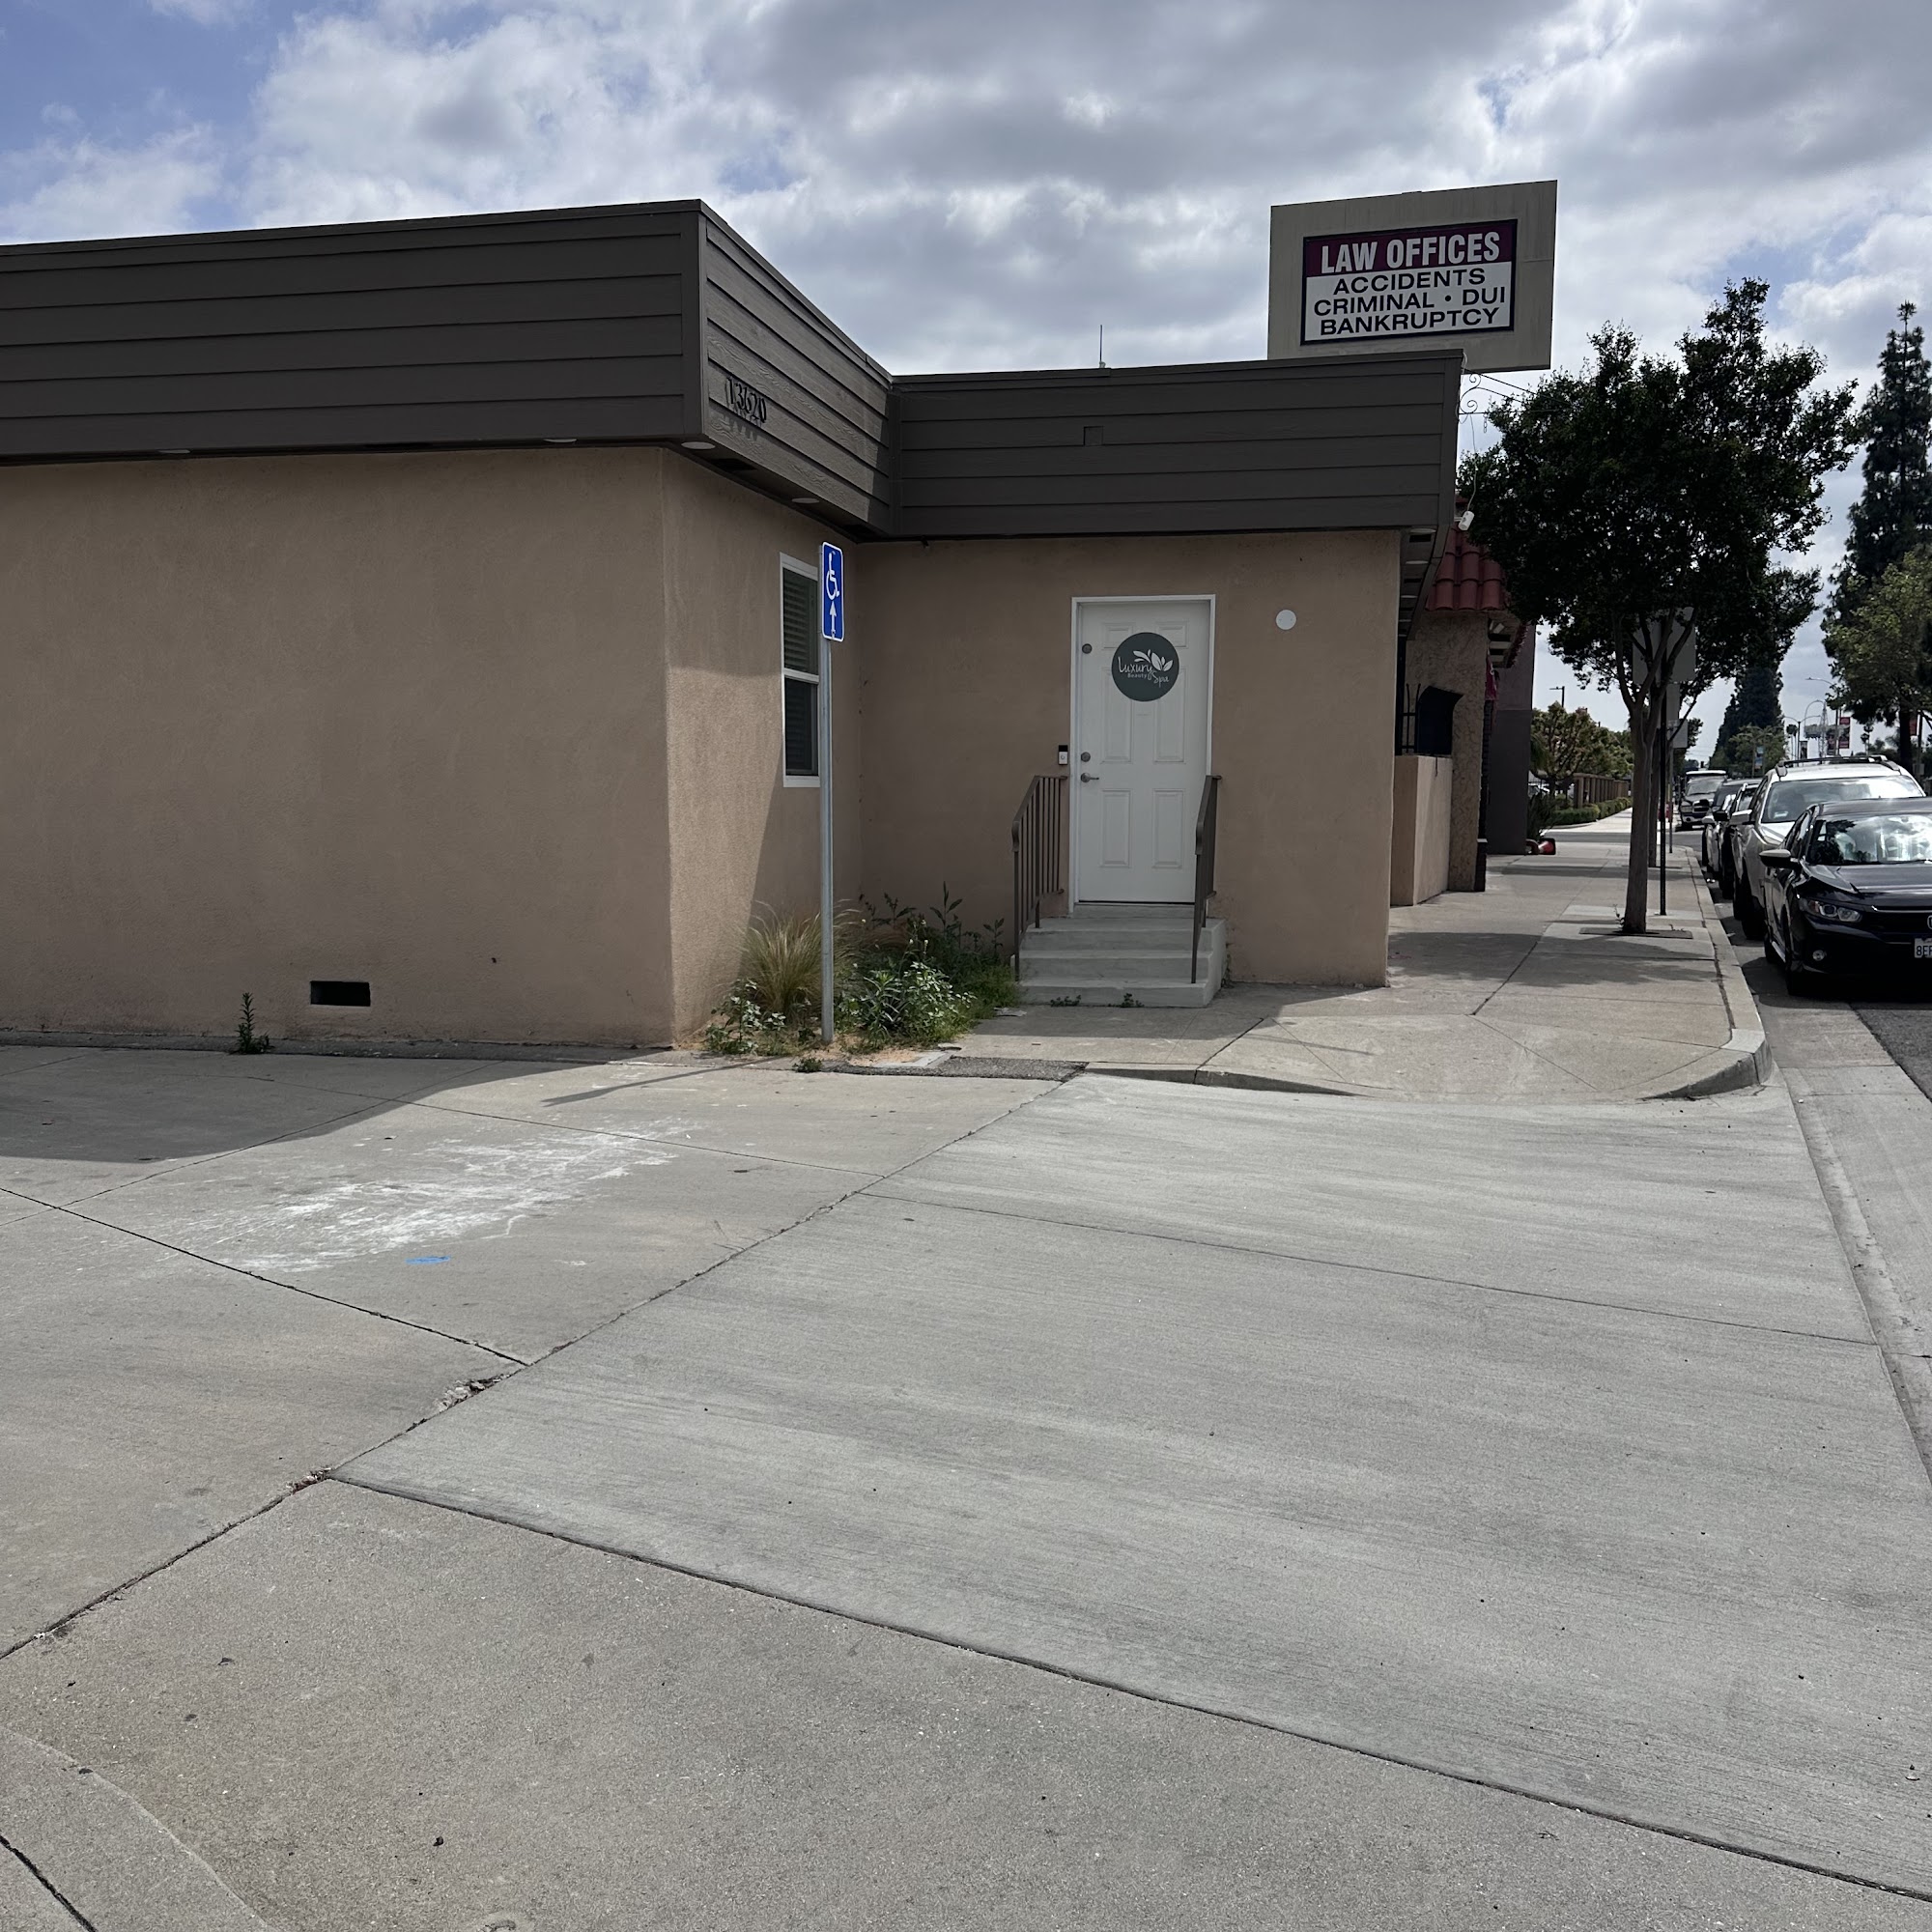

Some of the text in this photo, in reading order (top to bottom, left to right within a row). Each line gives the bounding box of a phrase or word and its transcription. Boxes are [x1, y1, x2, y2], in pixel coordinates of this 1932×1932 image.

[1321, 232, 1500, 273] LAW OFFICES
[1333, 268, 1486, 296] ACCIDENTS
[1314, 286, 1505, 316] CRIMINAL DUI
[1321, 307, 1499, 336] BANKRUPTCY
[726, 377, 767, 423] 13620
[1118, 656, 1153, 680] Luxury
[1151, 669, 1169, 688] Spa
